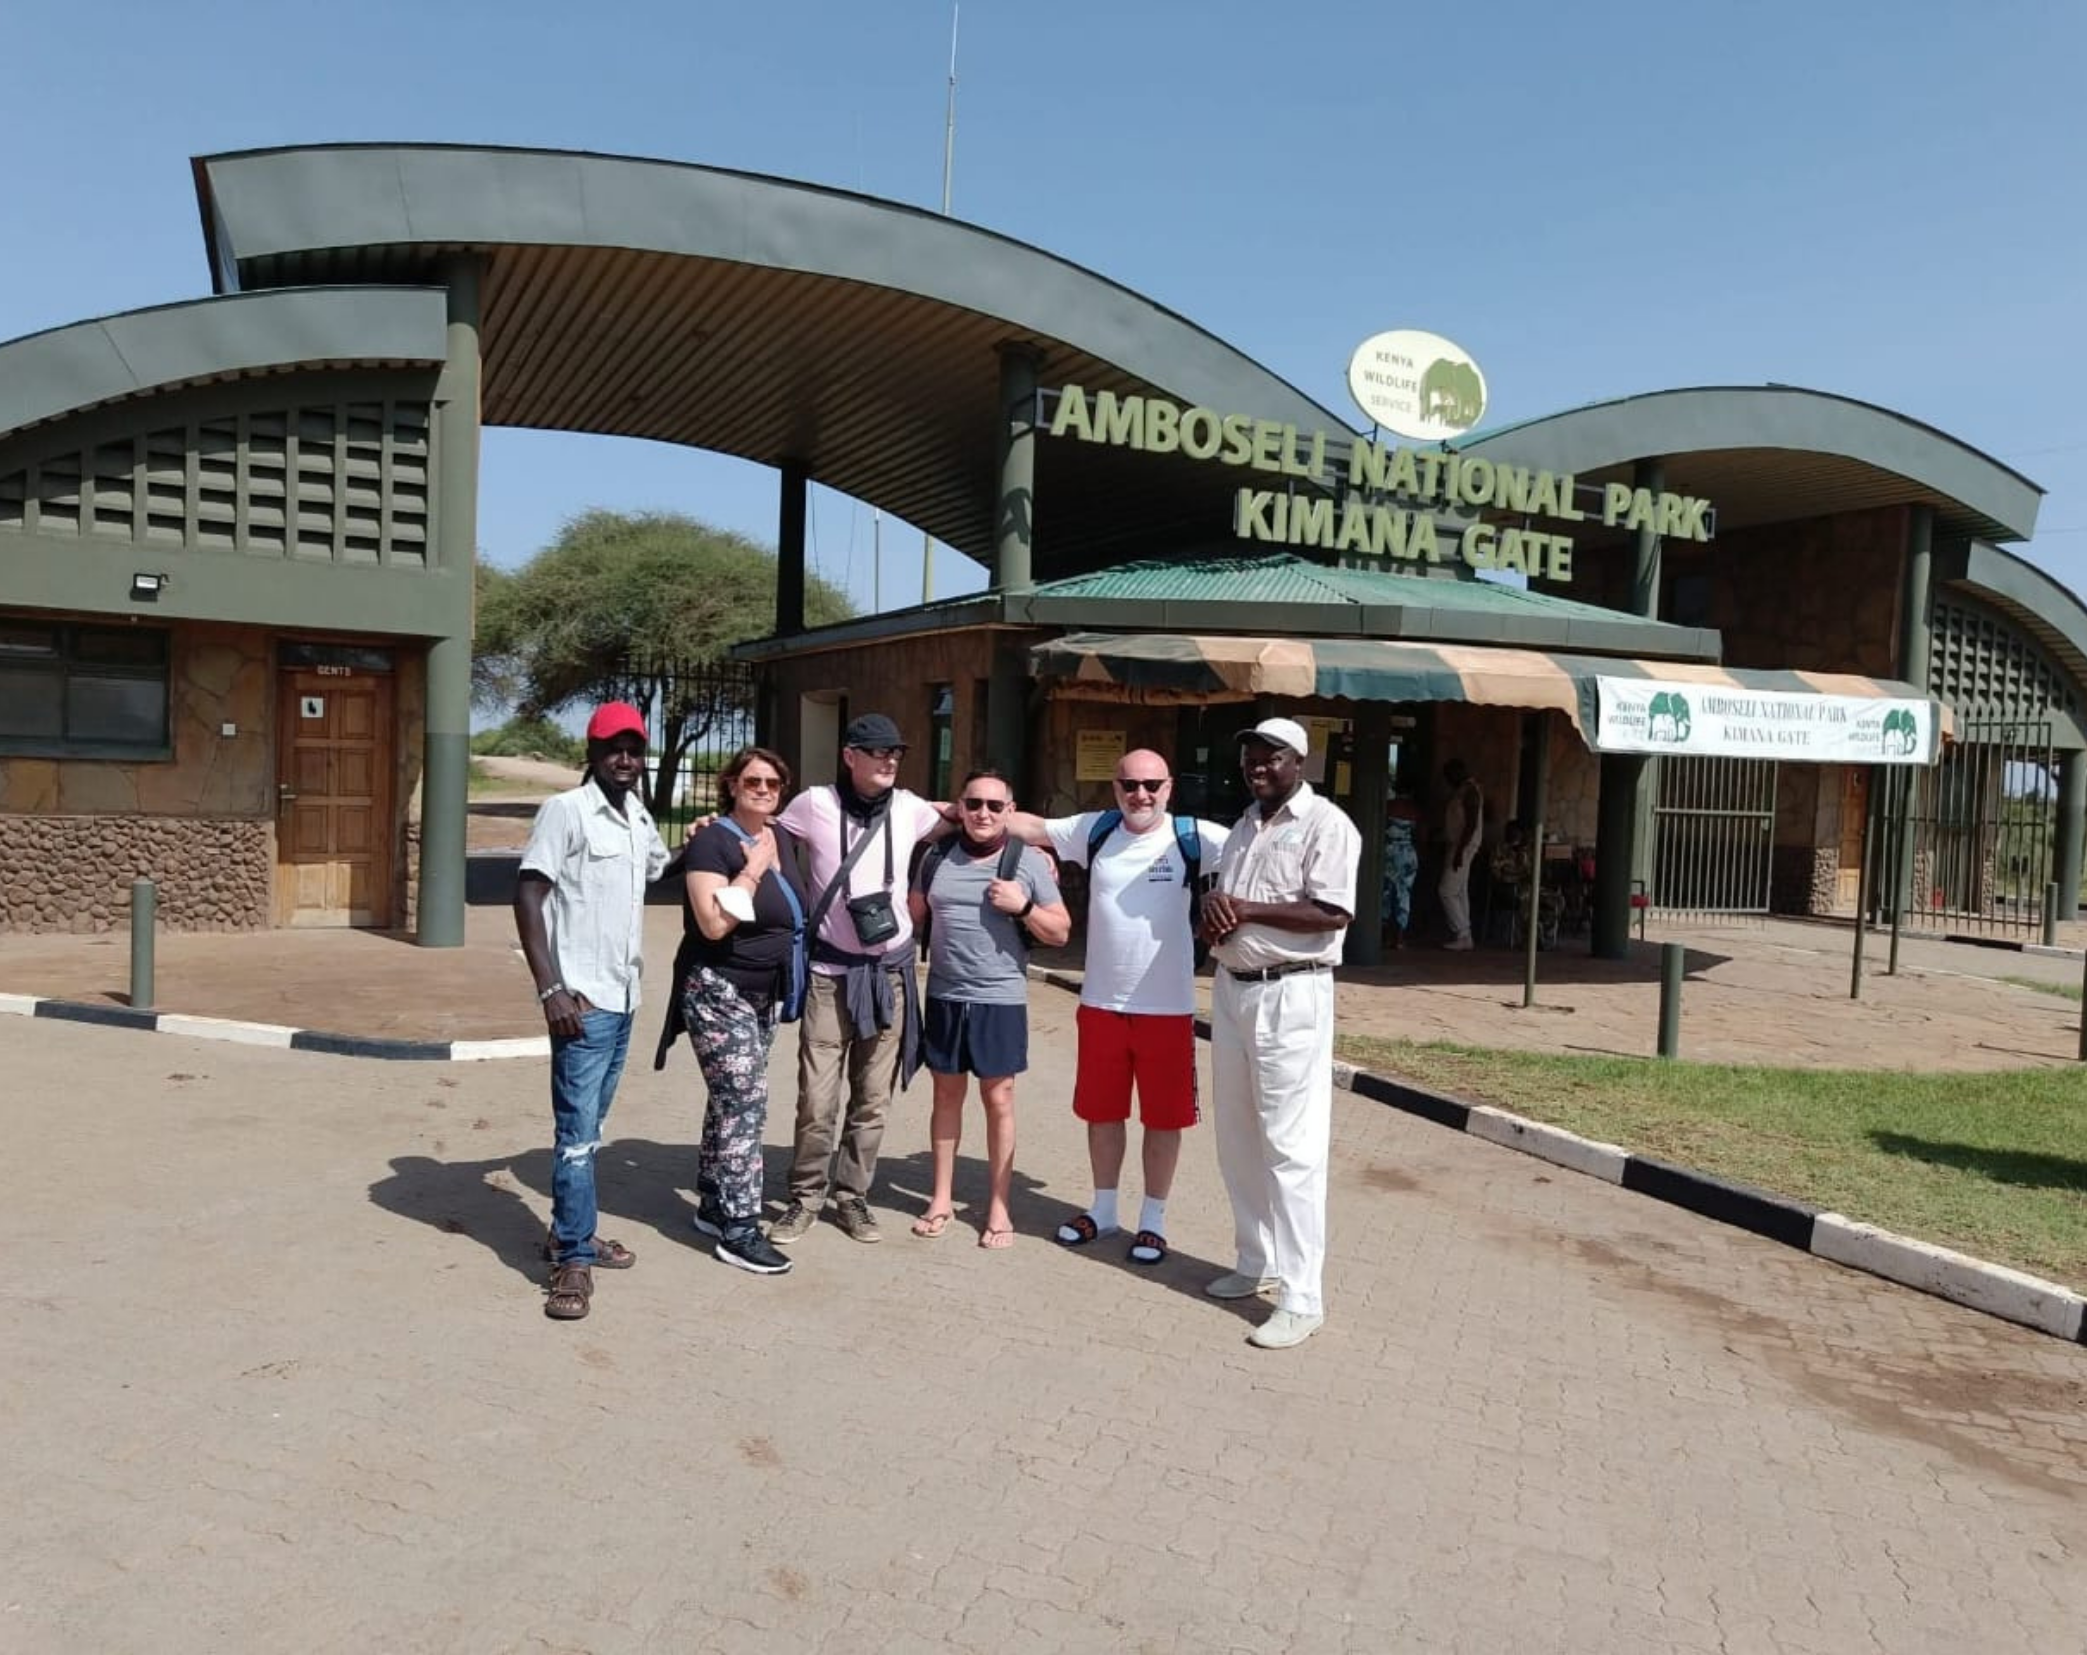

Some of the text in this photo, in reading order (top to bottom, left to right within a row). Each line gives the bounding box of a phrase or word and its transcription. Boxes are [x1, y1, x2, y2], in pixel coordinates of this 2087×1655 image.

[1363, 370, 1418, 394] WILDLIFE
[1376, 350, 1414, 369] KENYA
[1051, 384, 1710, 543] AMBOSELI NATIONAL PARK
[1236, 487, 1574, 582] KIMANA GATE
